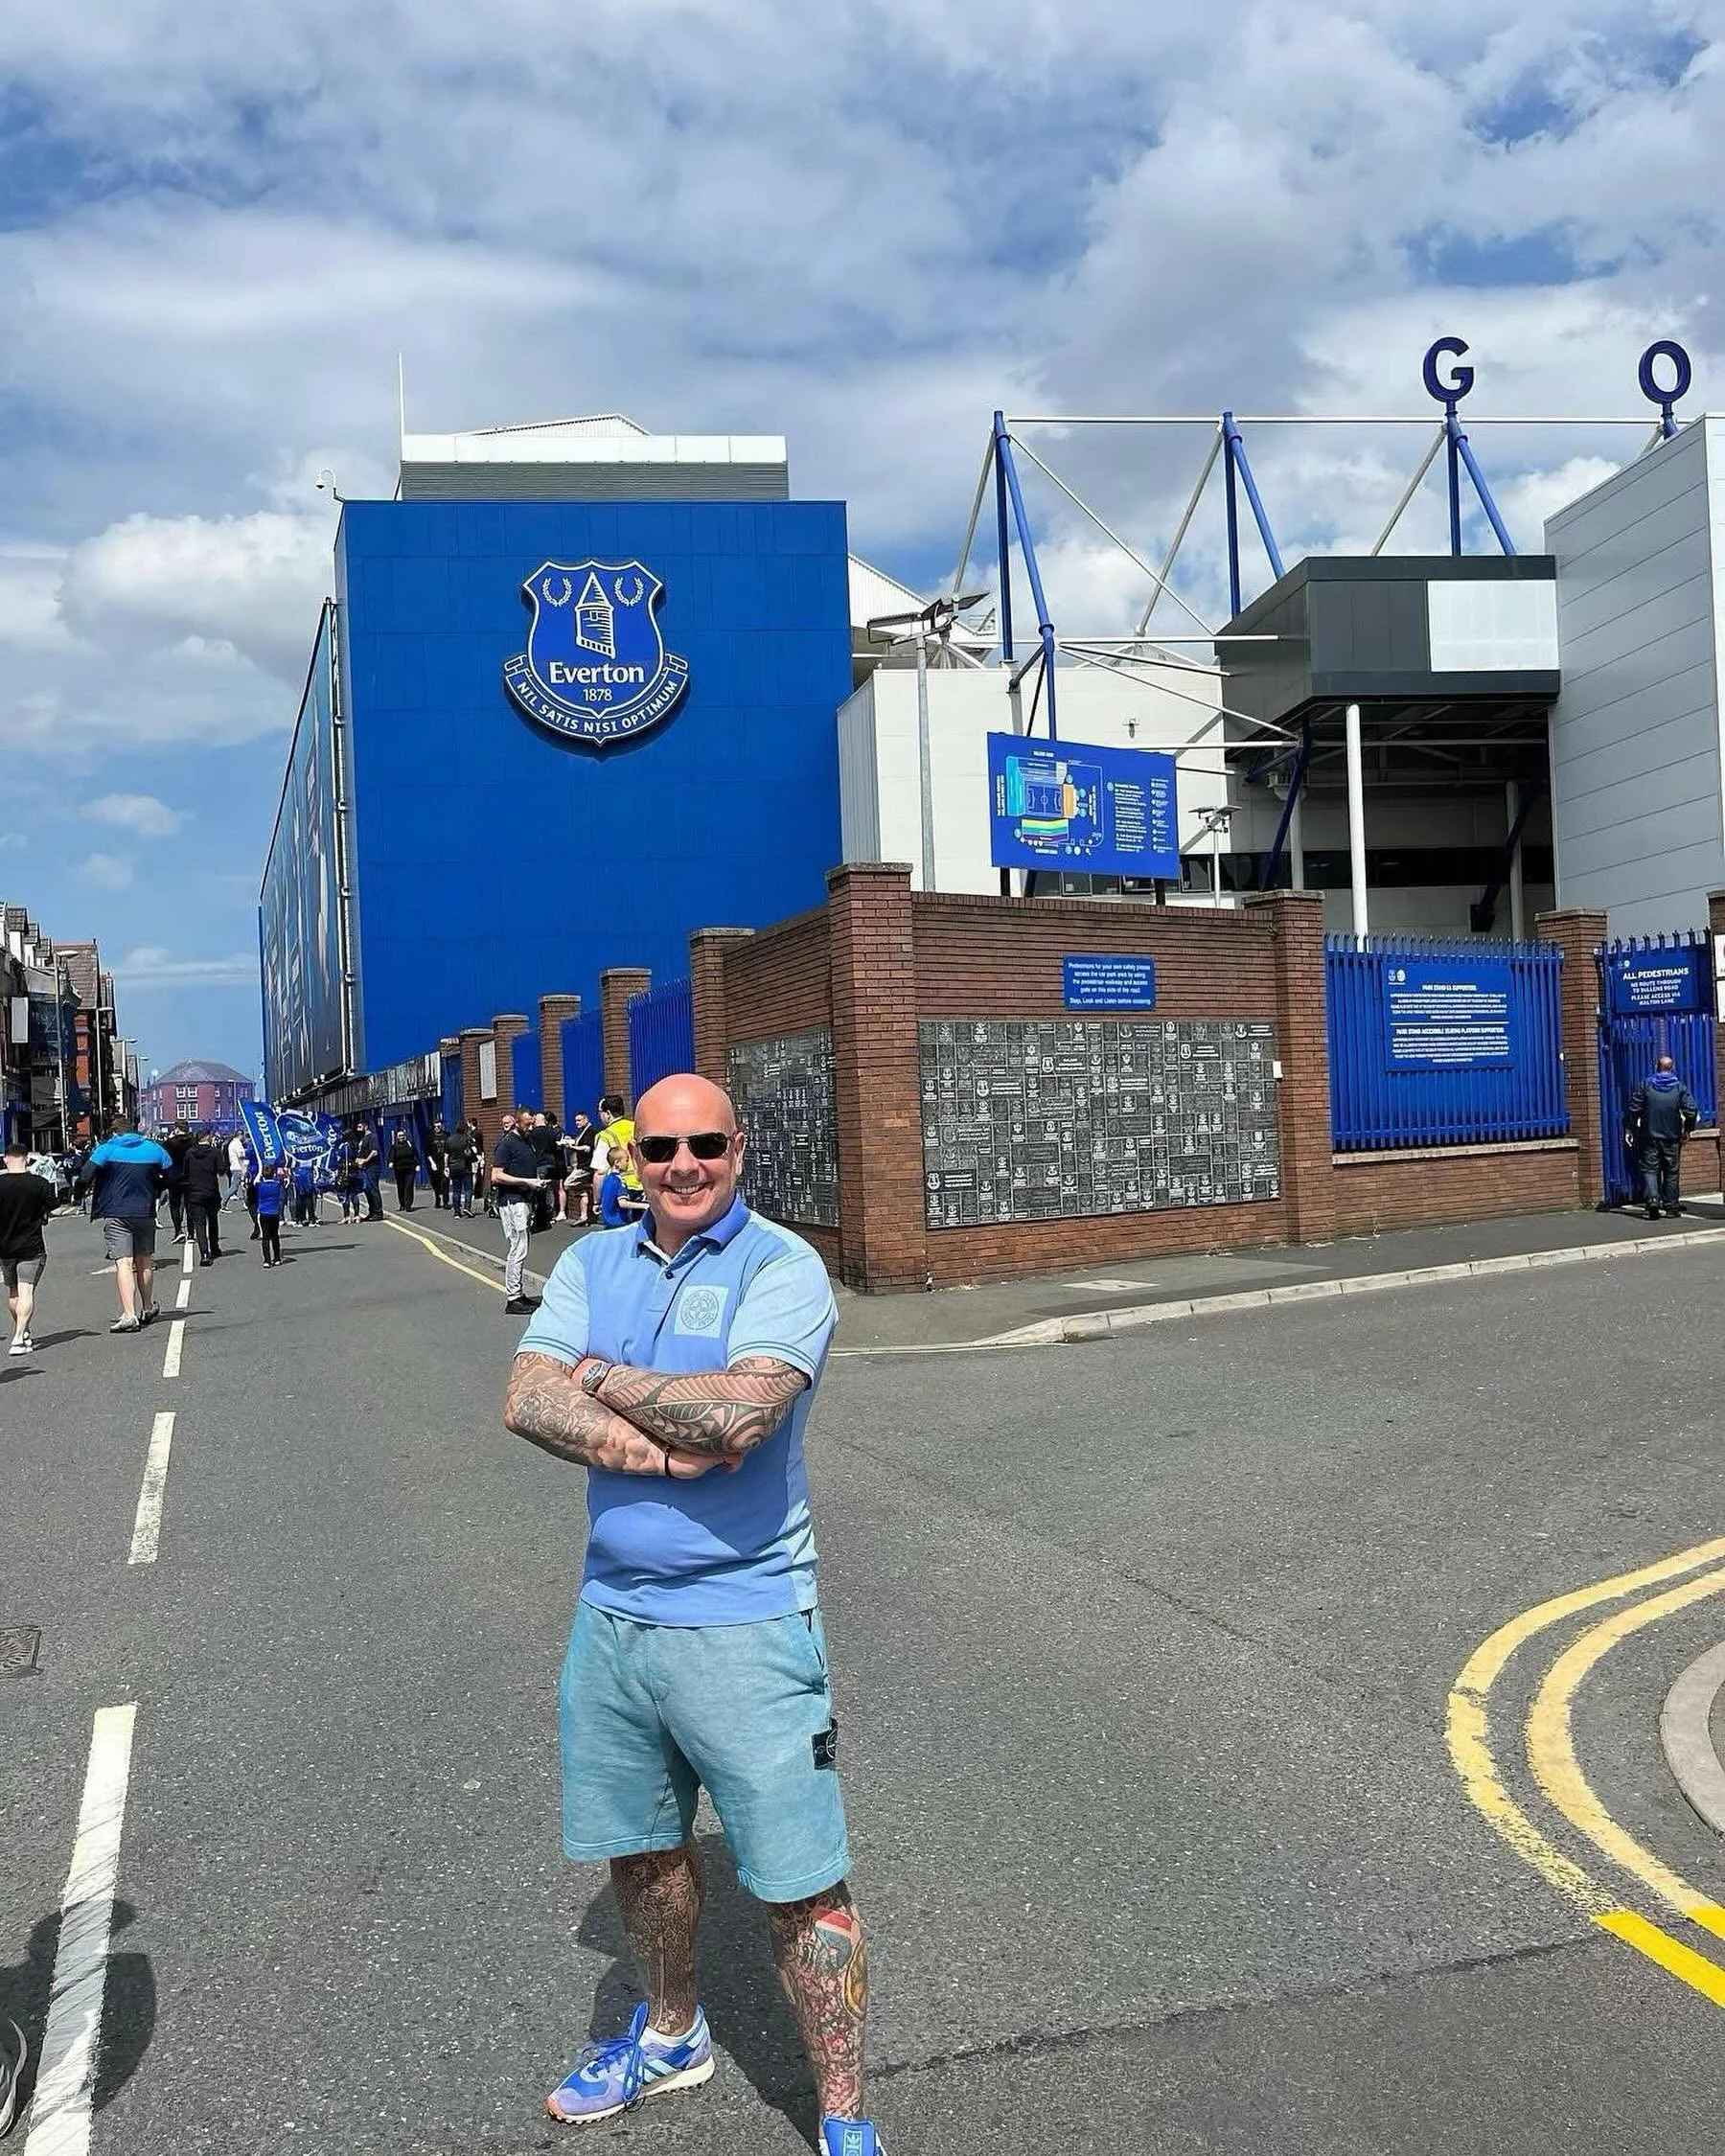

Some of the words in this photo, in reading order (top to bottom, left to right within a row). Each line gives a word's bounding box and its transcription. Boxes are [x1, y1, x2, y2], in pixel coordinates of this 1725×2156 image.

[1423, 336, 1474, 402] G
[1638, 340, 1691, 404] O
[550, 661, 644, 683] Everton
[517, 681, 537, 707] NIL
[539, 703, 579, 730] SATIS
[584, 721, 617, 733] NISI
[622, 680, 678, 729] OPTIMUM
[583, 689, 612, 701] 1878
[1637, 967, 1690, 978] PEDESTRIANS
[254, 1111, 276, 1159] Everton
